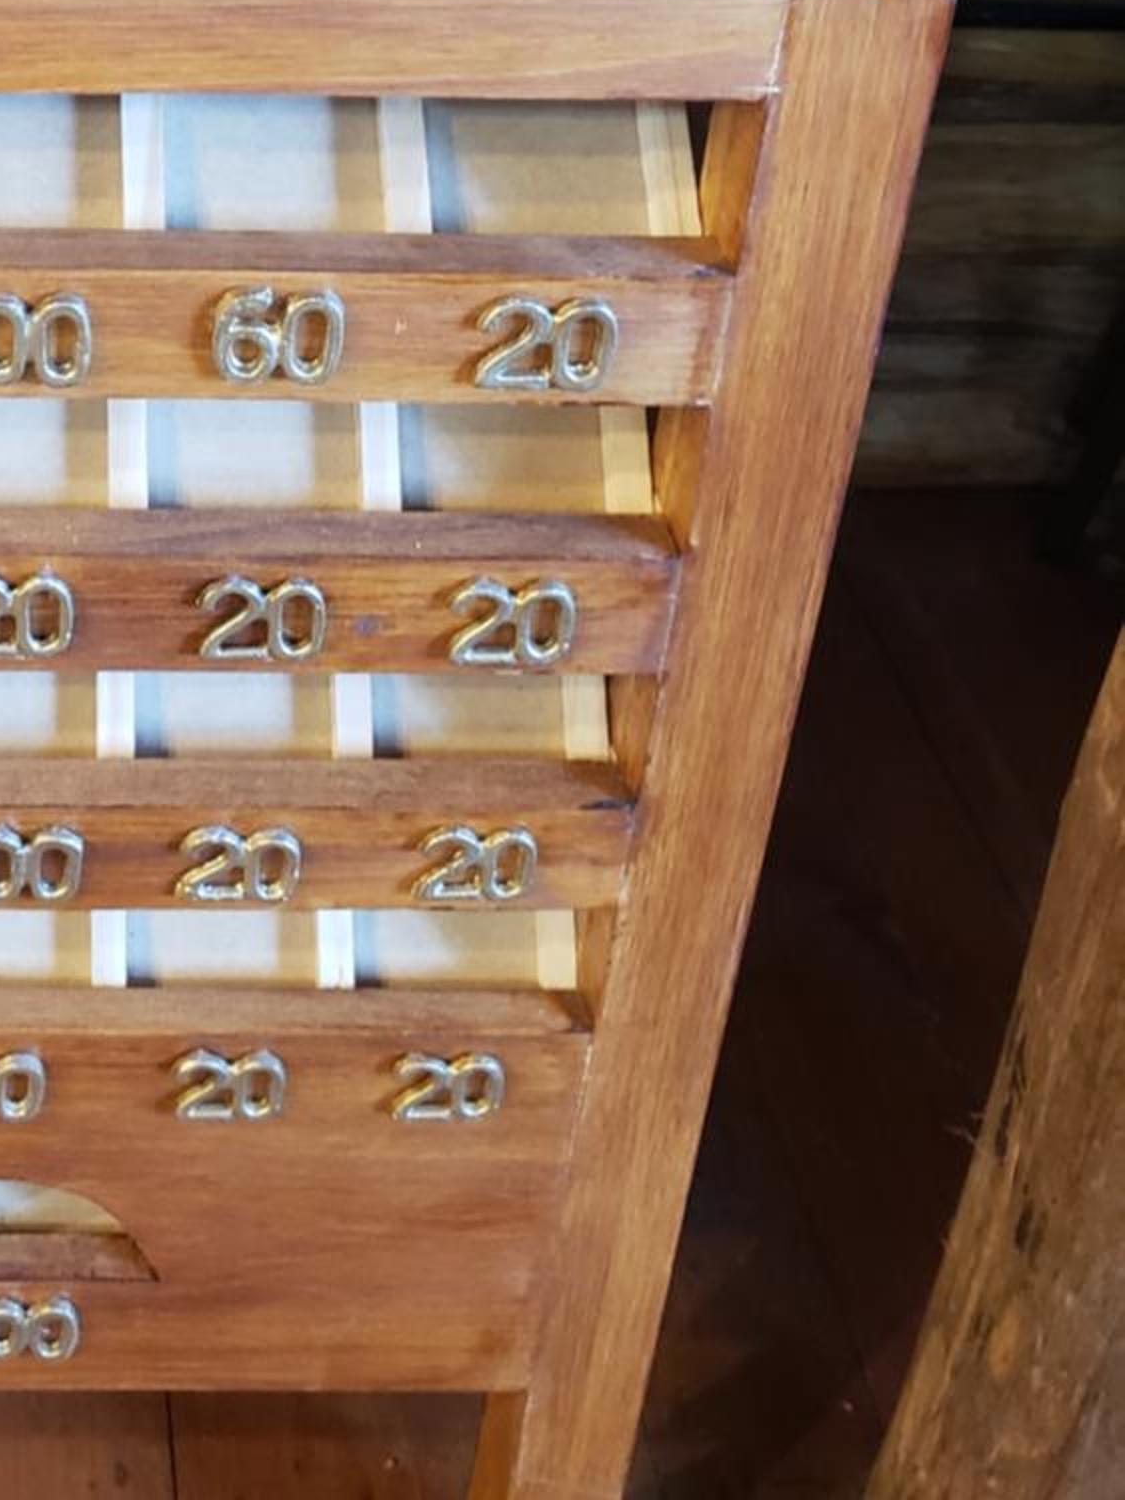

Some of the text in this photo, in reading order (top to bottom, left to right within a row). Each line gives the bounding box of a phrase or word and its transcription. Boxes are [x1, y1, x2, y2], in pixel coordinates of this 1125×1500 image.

[213, 286, 346, 387] 60
[476, 295, 619, 390] 20
[195, 575, 327, 661] 20
[447, 576, 576, 665] 20
[175, 823, 302, 902] 20
[410, 823, 537, 901] 20
[174, 1049, 287, 1122] 20
[391, 1051, 507, 1124] 20
